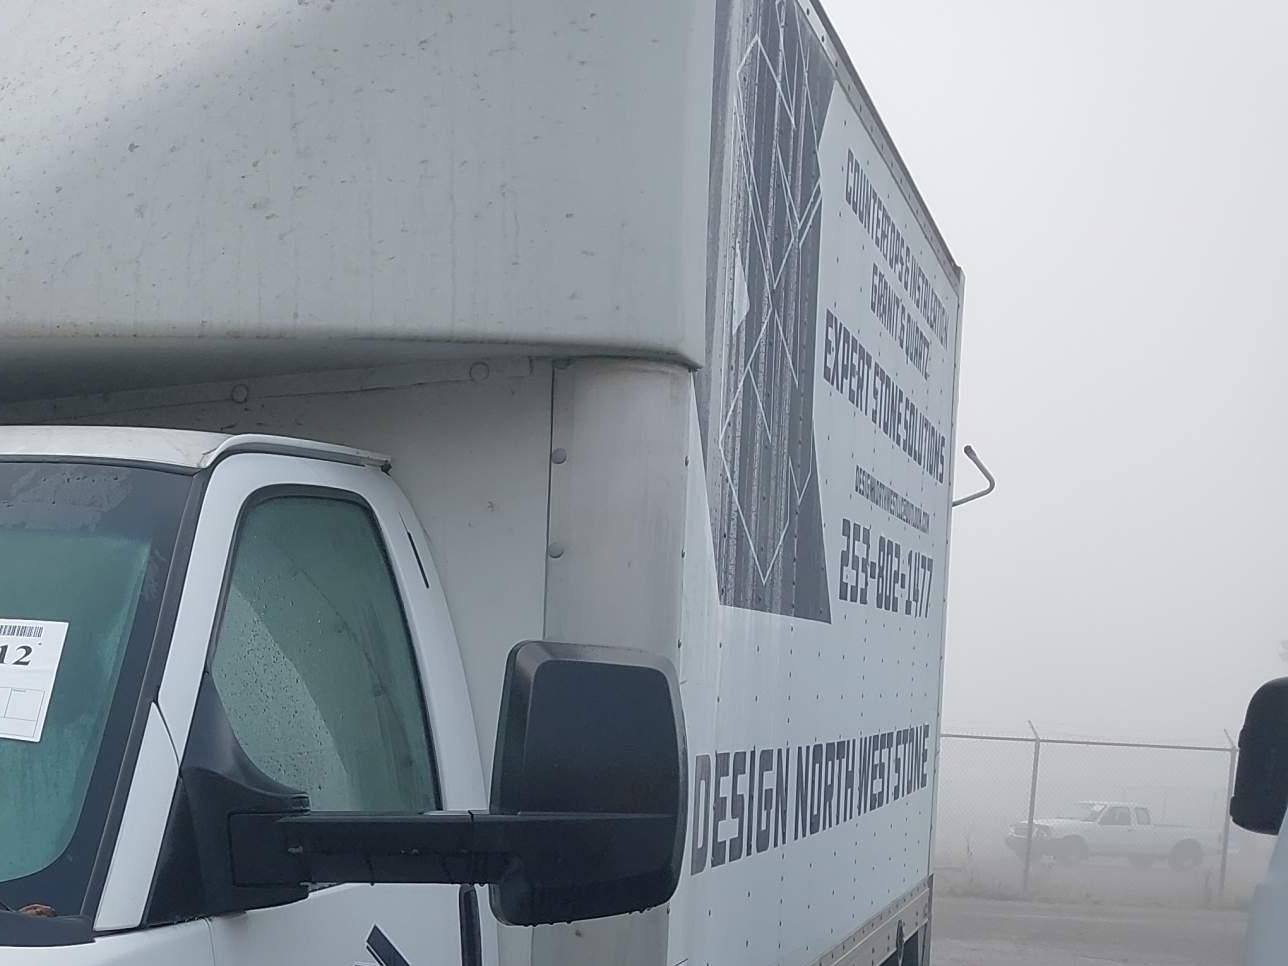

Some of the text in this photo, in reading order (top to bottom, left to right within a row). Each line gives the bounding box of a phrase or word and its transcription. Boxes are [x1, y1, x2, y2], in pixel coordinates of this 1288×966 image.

[845, 148, 905, 283] COUNTERTOPS
[824, 308, 872, 416] EXPERT
[872, 361, 904, 448] STONE
[903, 397, 946, 484] SOLUTIONS
[905, 313, 930, 381] QUARTZ
[839, 518, 934, 618] 253-802-1477
[690, 724, 930, 876] DESIGN NORTH WEST STONE
